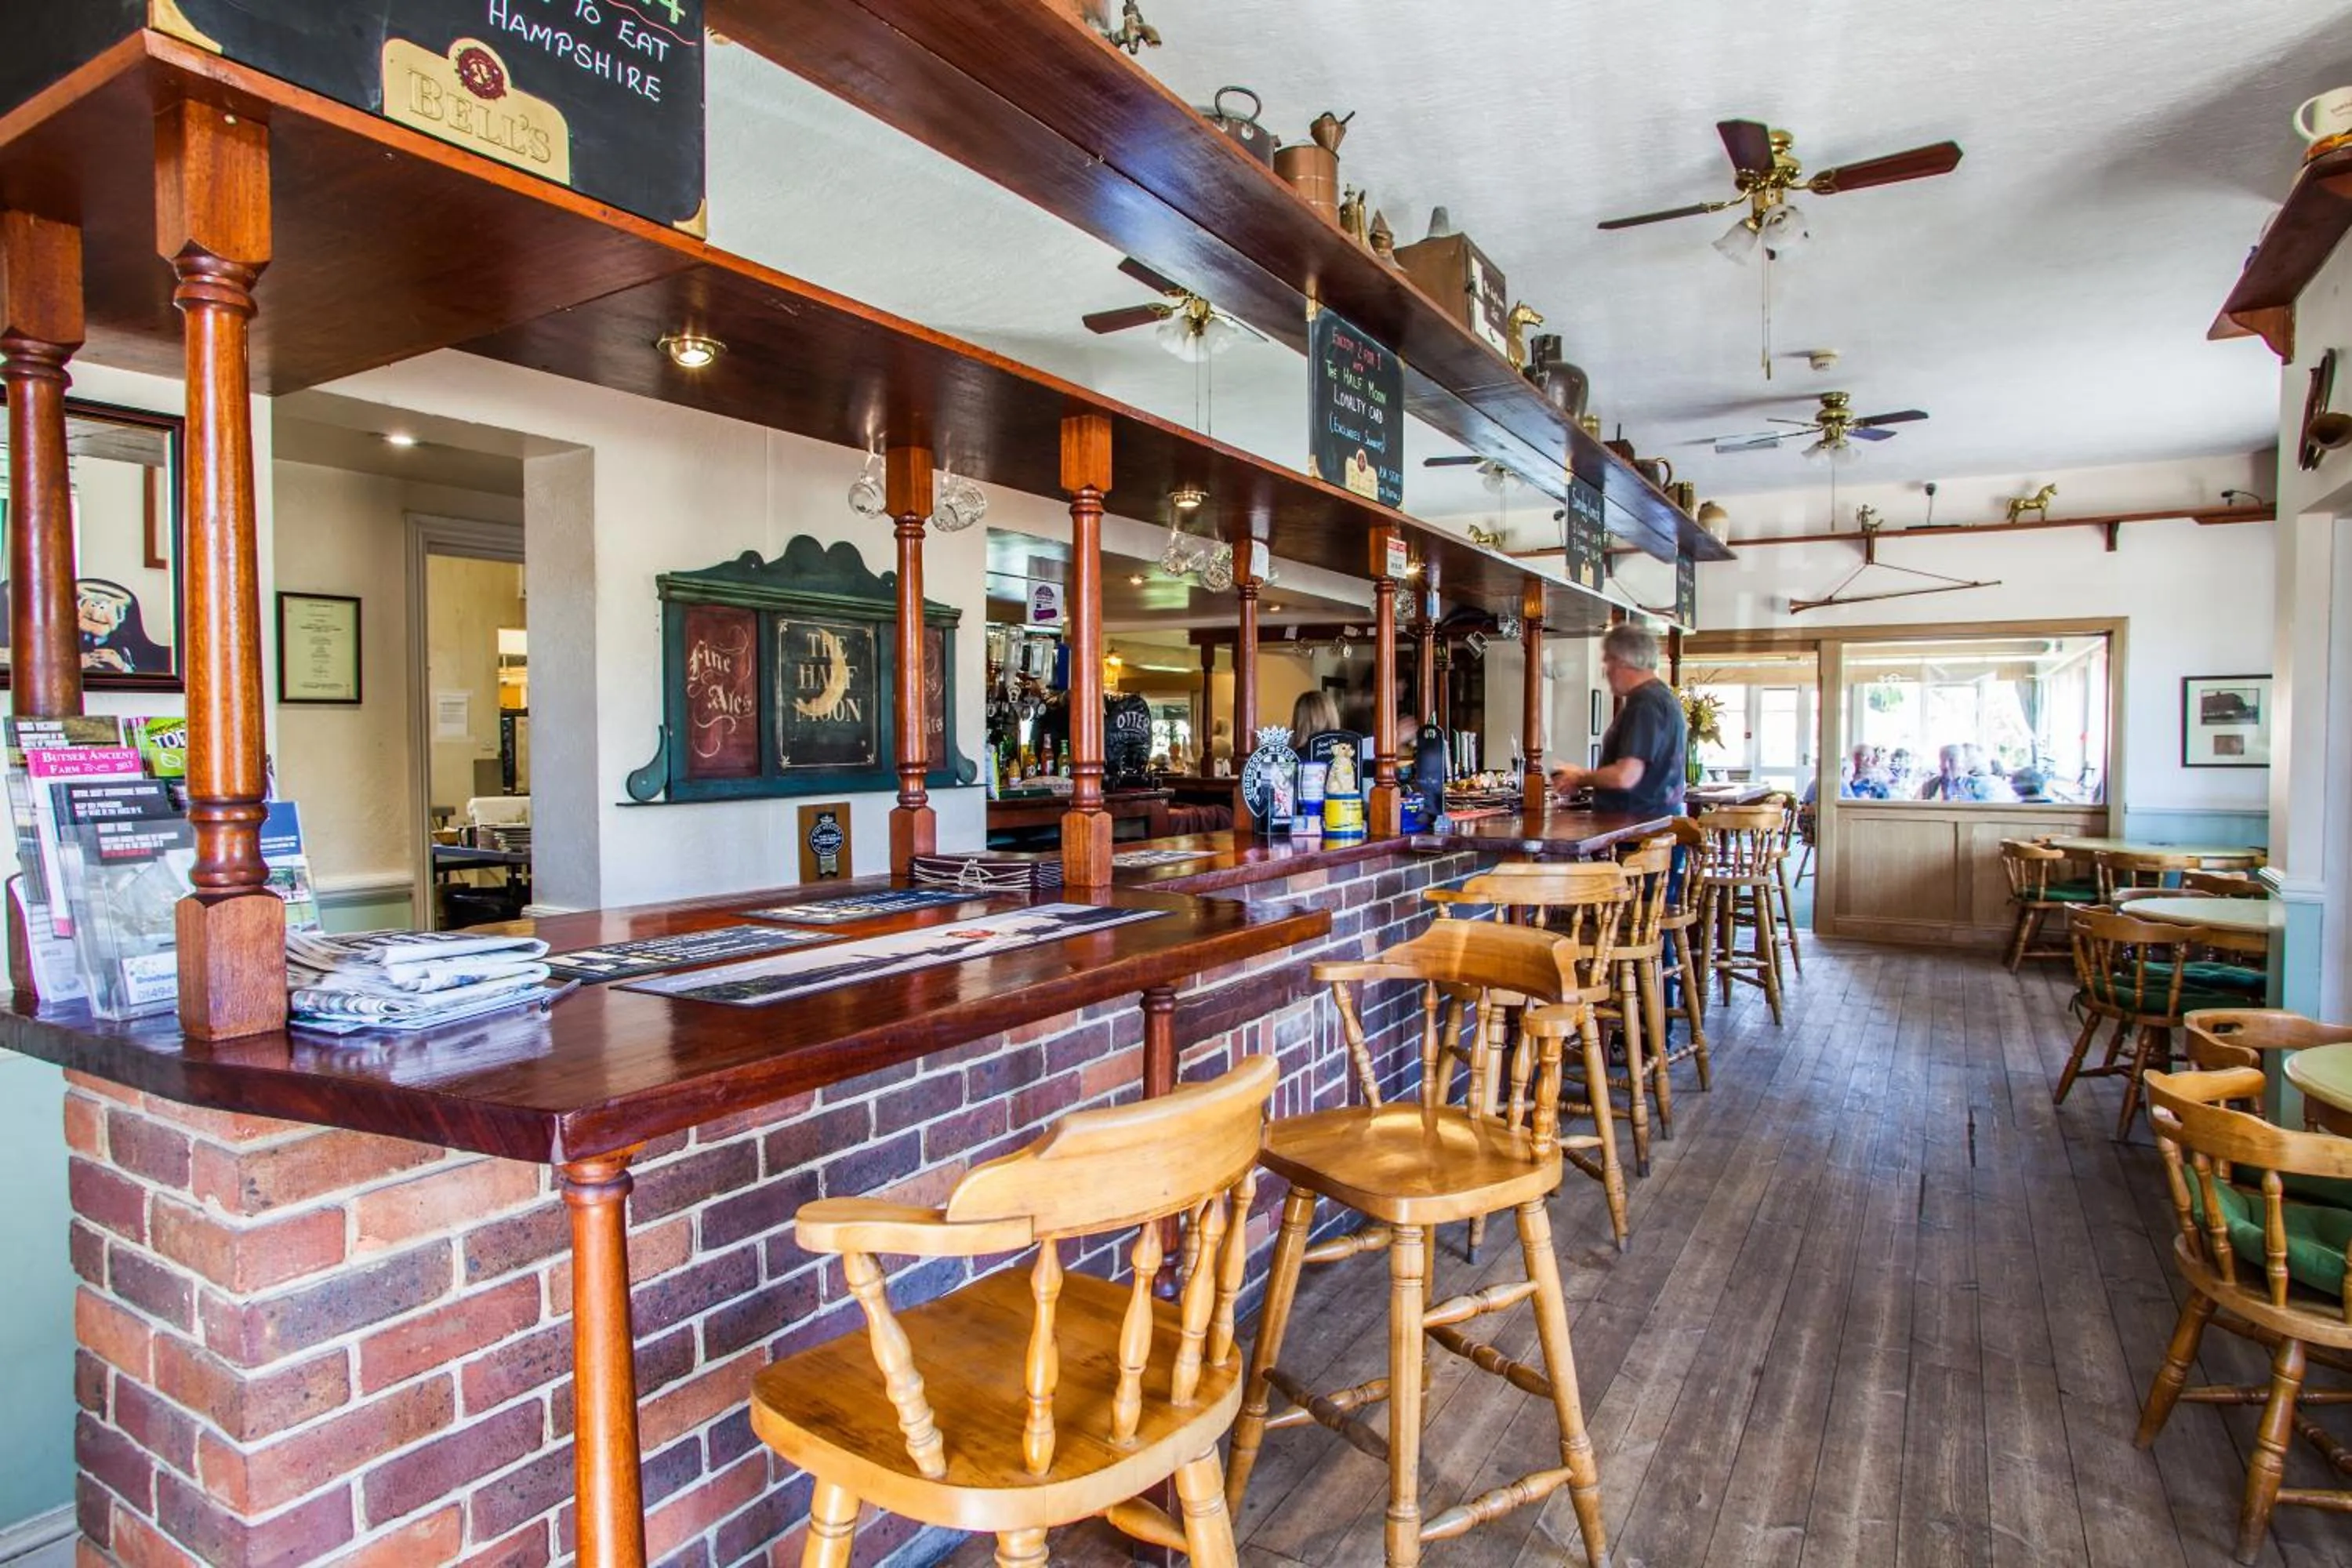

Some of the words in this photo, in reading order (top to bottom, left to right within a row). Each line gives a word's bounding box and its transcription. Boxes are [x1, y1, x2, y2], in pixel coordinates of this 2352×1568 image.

[488, 0, 662, 102] HAMPSHIRE
[618, 20, 670, 63] EAT
[407, 67, 552, 165] BELL'S
[688, 639, 731, 681] Fine
[800, 664, 859, 690] HAF
[708, 683, 753, 715] Ales
[1116, 711, 1150, 735] OTTER
[49, 764, 81, 775] FARM
